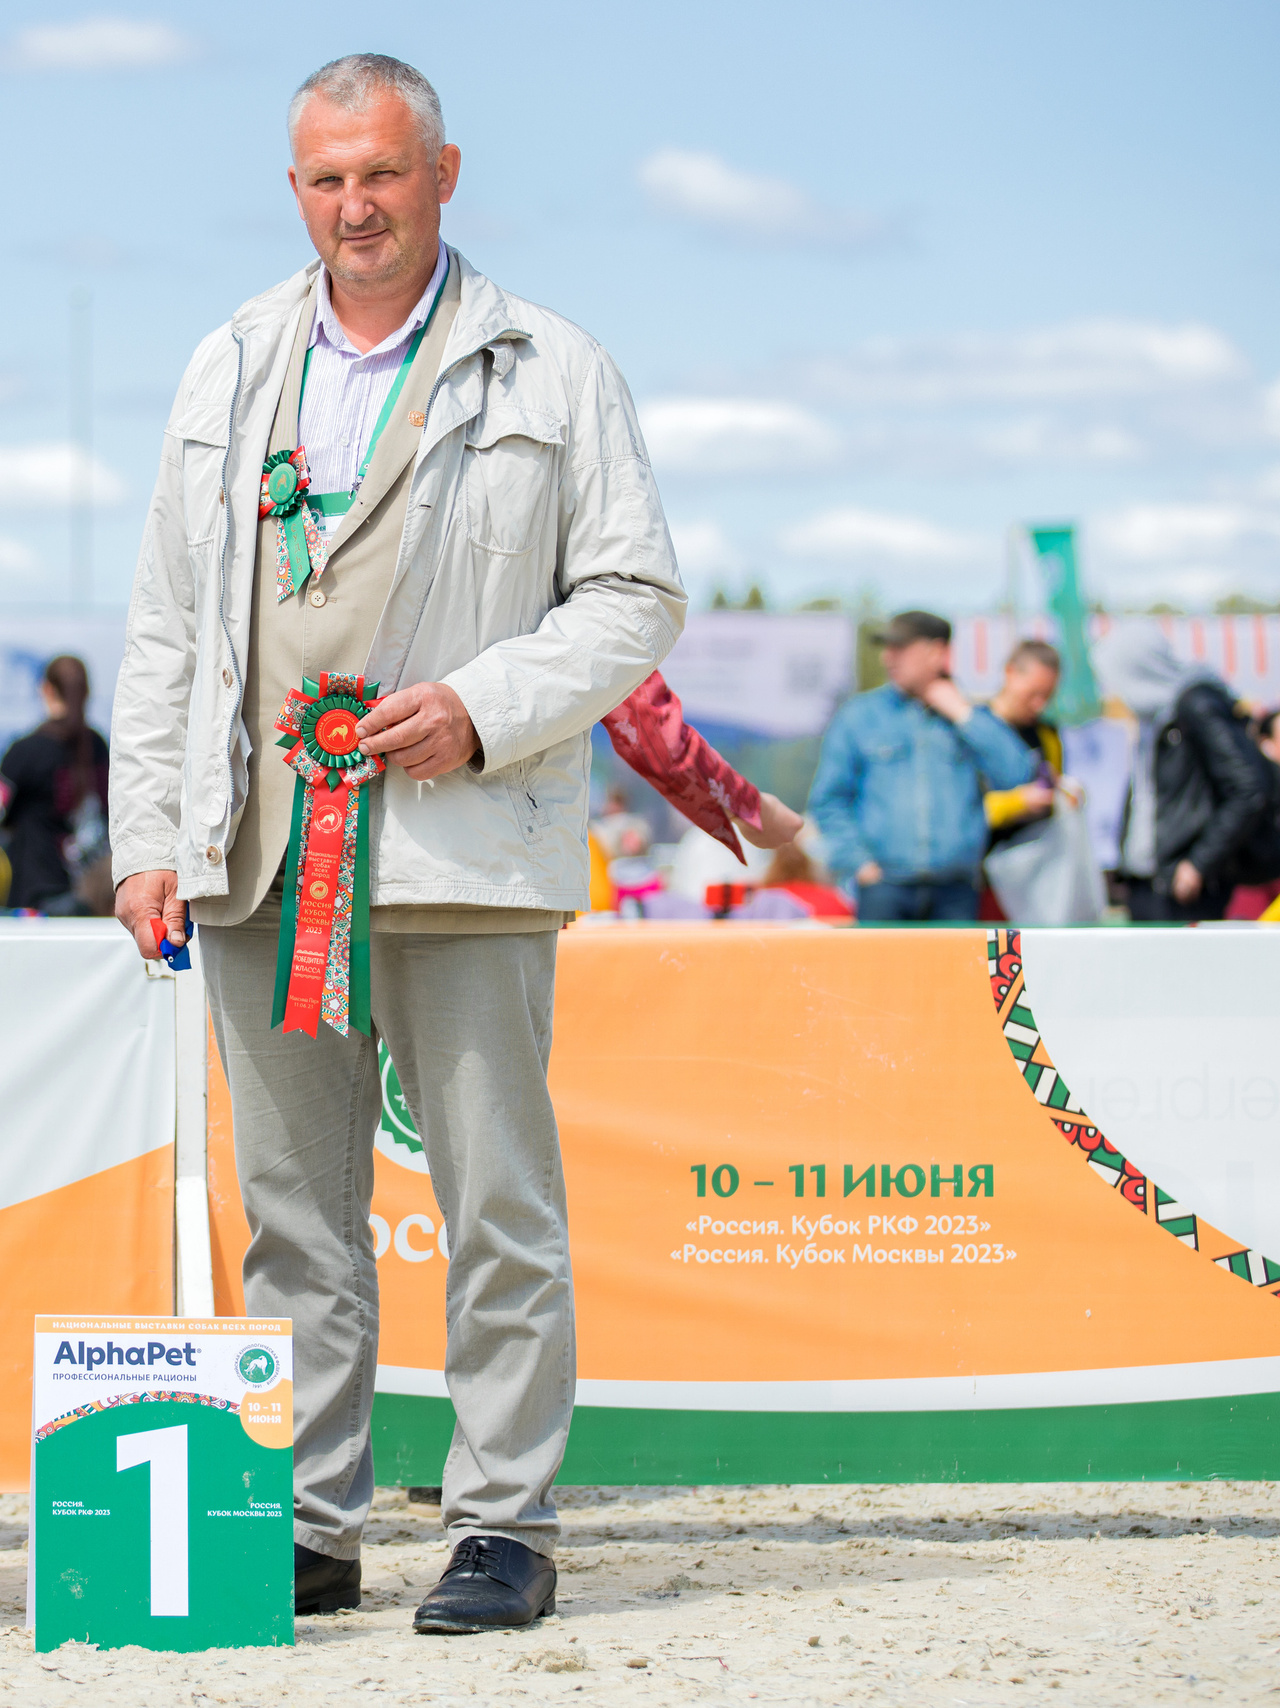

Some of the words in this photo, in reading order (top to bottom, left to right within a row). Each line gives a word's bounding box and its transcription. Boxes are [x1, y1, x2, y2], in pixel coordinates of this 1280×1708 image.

[302, 900, 332, 909] РОССИЯ
[304, 908, 327, 917] КУБОК
[300, 916, 330, 926] МОСКВЫ
[305, 925, 323, 935] 2023
[295, 964, 321, 974] КЛАССА
[689, 1163, 740, 1198] 10
[788, 1163, 826, 1198] 11
[843, 1163, 994, 1198] ИЮНЯ
[685, 1214, 785, 1236] «Россия.
[791, 1213, 861, 1241] Кубок
[868, 1214, 919, 1236] РКФ
[924, 1214, 992, 1236] 2023»
[670, 1243, 769, 1264] «Россия.
[775, 1242, 845, 1270] Кубок
[851, 1243, 944, 1264] Москвы
[950, 1243, 1017, 1264] 2023»
[52, 1321, 132, 1330] НАЦИОНАЛЬНЫЕ
[134, 1322, 186, 1330] ВЫСТАВКИ
[188, 1323, 220, 1331] СОБАК
[222, 1323, 246, 1331] ВСЕХ
[249, 1324, 281, 1332] ПОРОД
[52, 1373, 150, 1381] ПРОФЕССИОНАЛЬНЫЕ
[153, 1373, 197, 1383] РАЦИОНЫ
[248, 1402, 260, 1412] 10
[271, 1403, 281, 1412] 11
[248, 1414, 282, 1424] ИЮНЯ
[52, 1500, 85, 1508] РОССИЯ.
[52, 1508, 77, 1516] КУБОК
[78, 1508, 94, 1516] РКФ
[266, 1510, 283, 1518] 2023
[116, 1424, 189, 1616] 1
